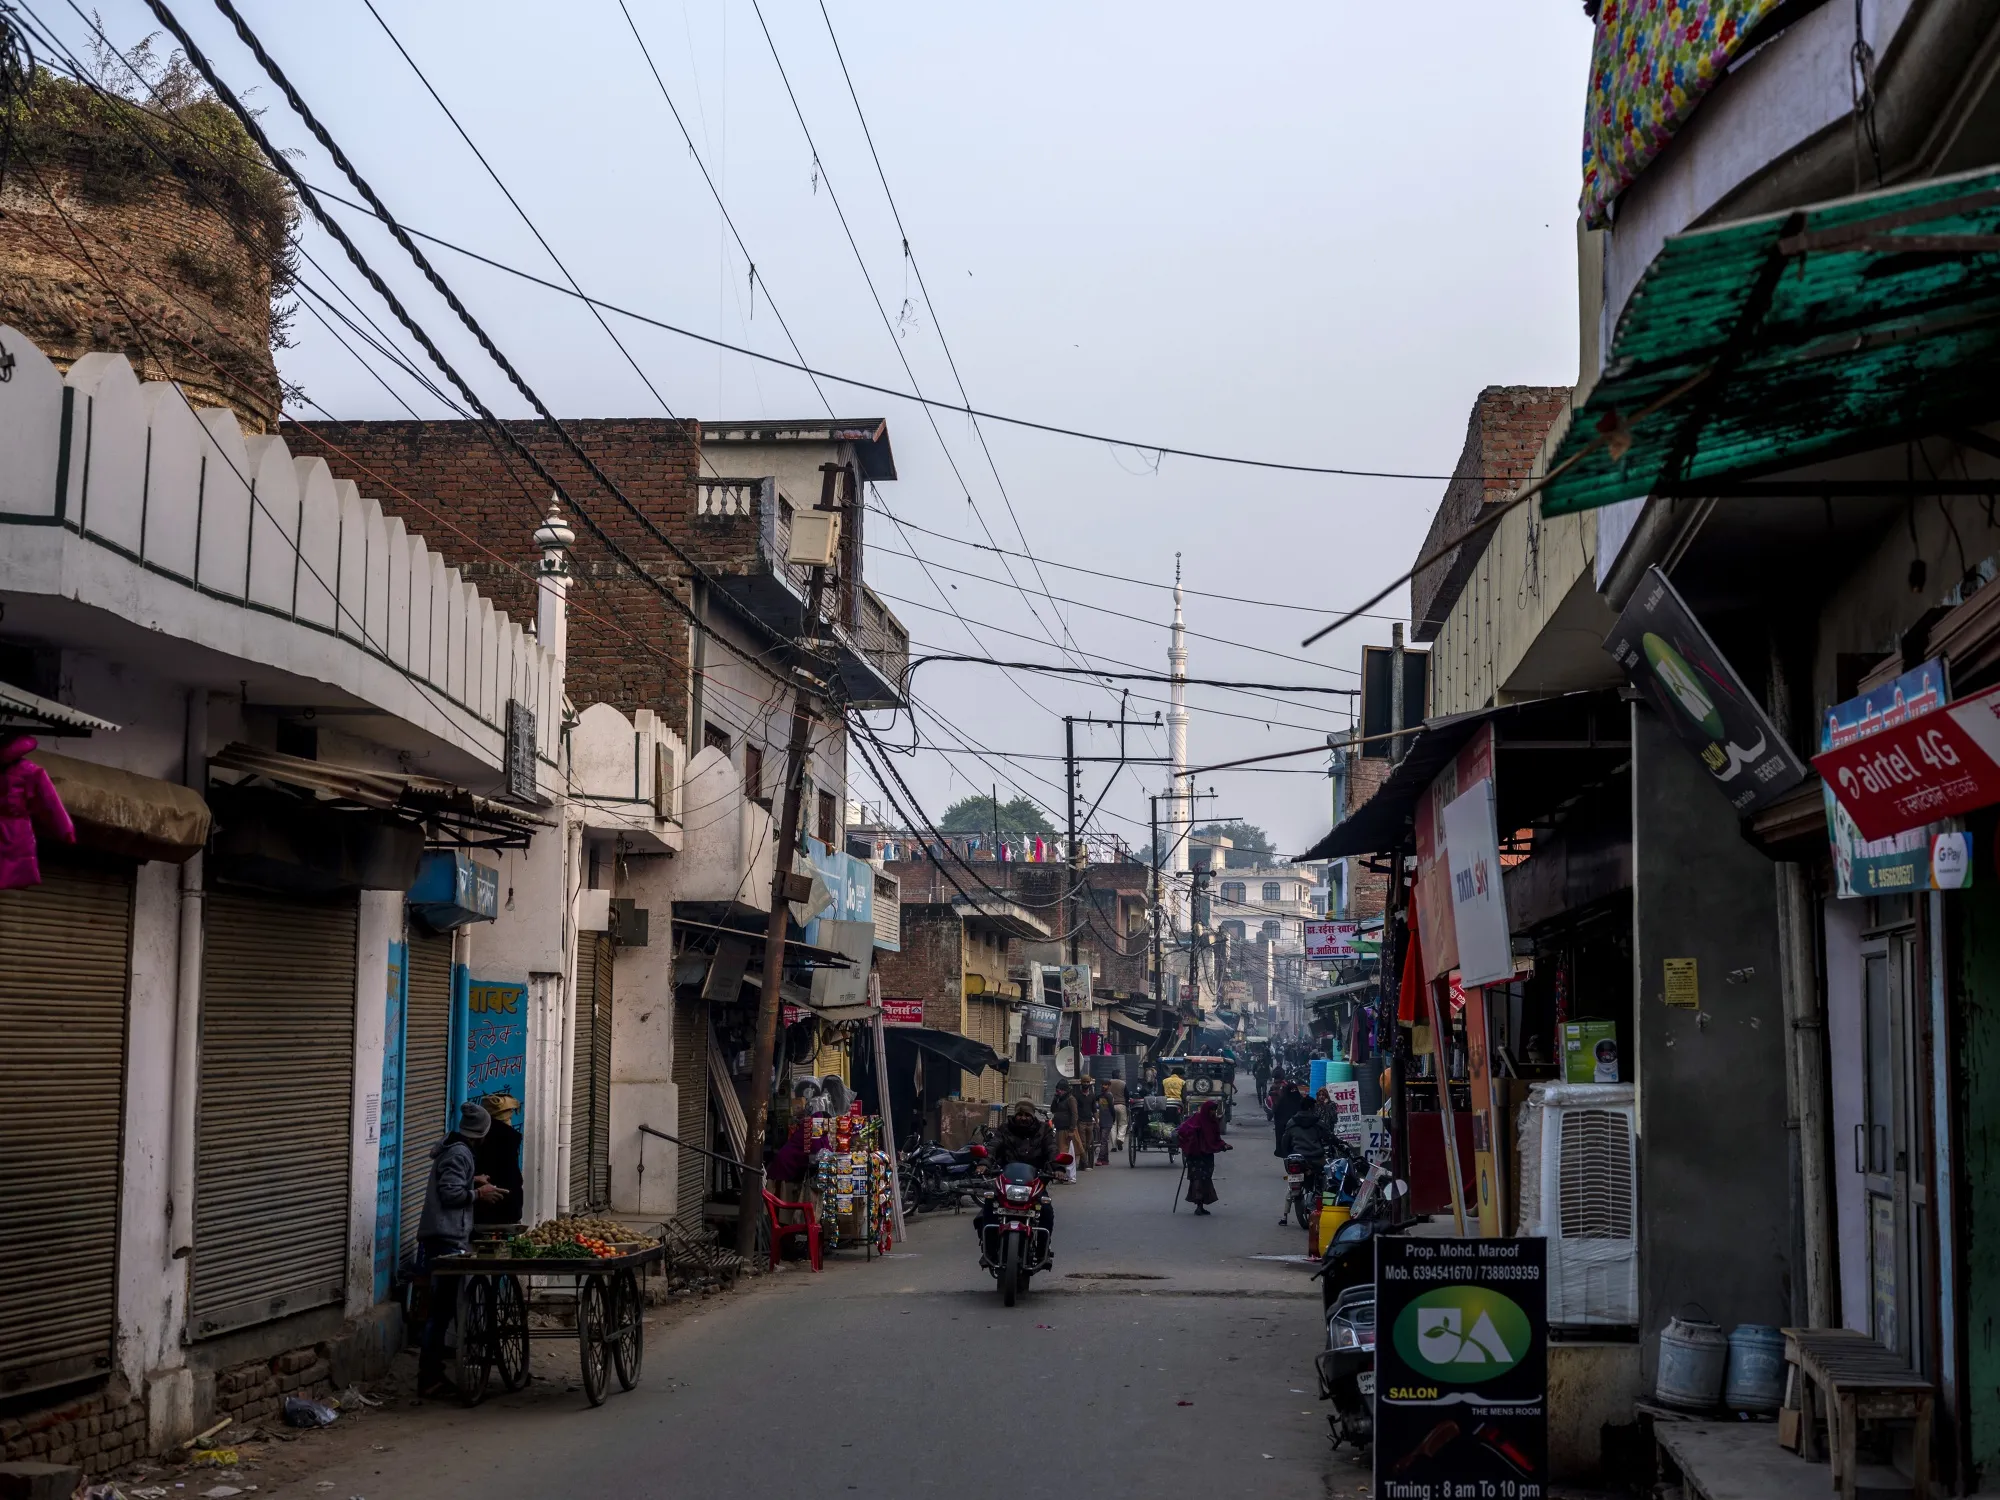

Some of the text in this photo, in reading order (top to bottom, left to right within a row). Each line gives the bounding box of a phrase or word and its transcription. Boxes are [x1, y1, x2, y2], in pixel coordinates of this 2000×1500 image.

[1856, 729, 1960, 793] airtel 4G
[1947, 847, 1961, 864] Pay
[1456, 868, 1475, 903] TATA
[1405, 1244, 1519, 1260] Prop. Mohd. Maroof
[1385, 1265, 1411, 1280] Mob.
[1413, 1265, 1472, 1280] 6394541670
[1480, 1265, 1540, 1280] 7388039359
[1389, 1387, 1438, 1399] SALON
[1471, 1407, 1541, 1416] THE MENS ROOM
[1384, 1480, 1430, 1500] Timing
[1443, 1480, 1451, 1498] 8
[1455, 1484, 1476, 1498] am
[1478, 1480, 1496, 1498] To
[1499, 1480, 1515, 1498] 10
[1519, 1484, 1540, 1500] pm
